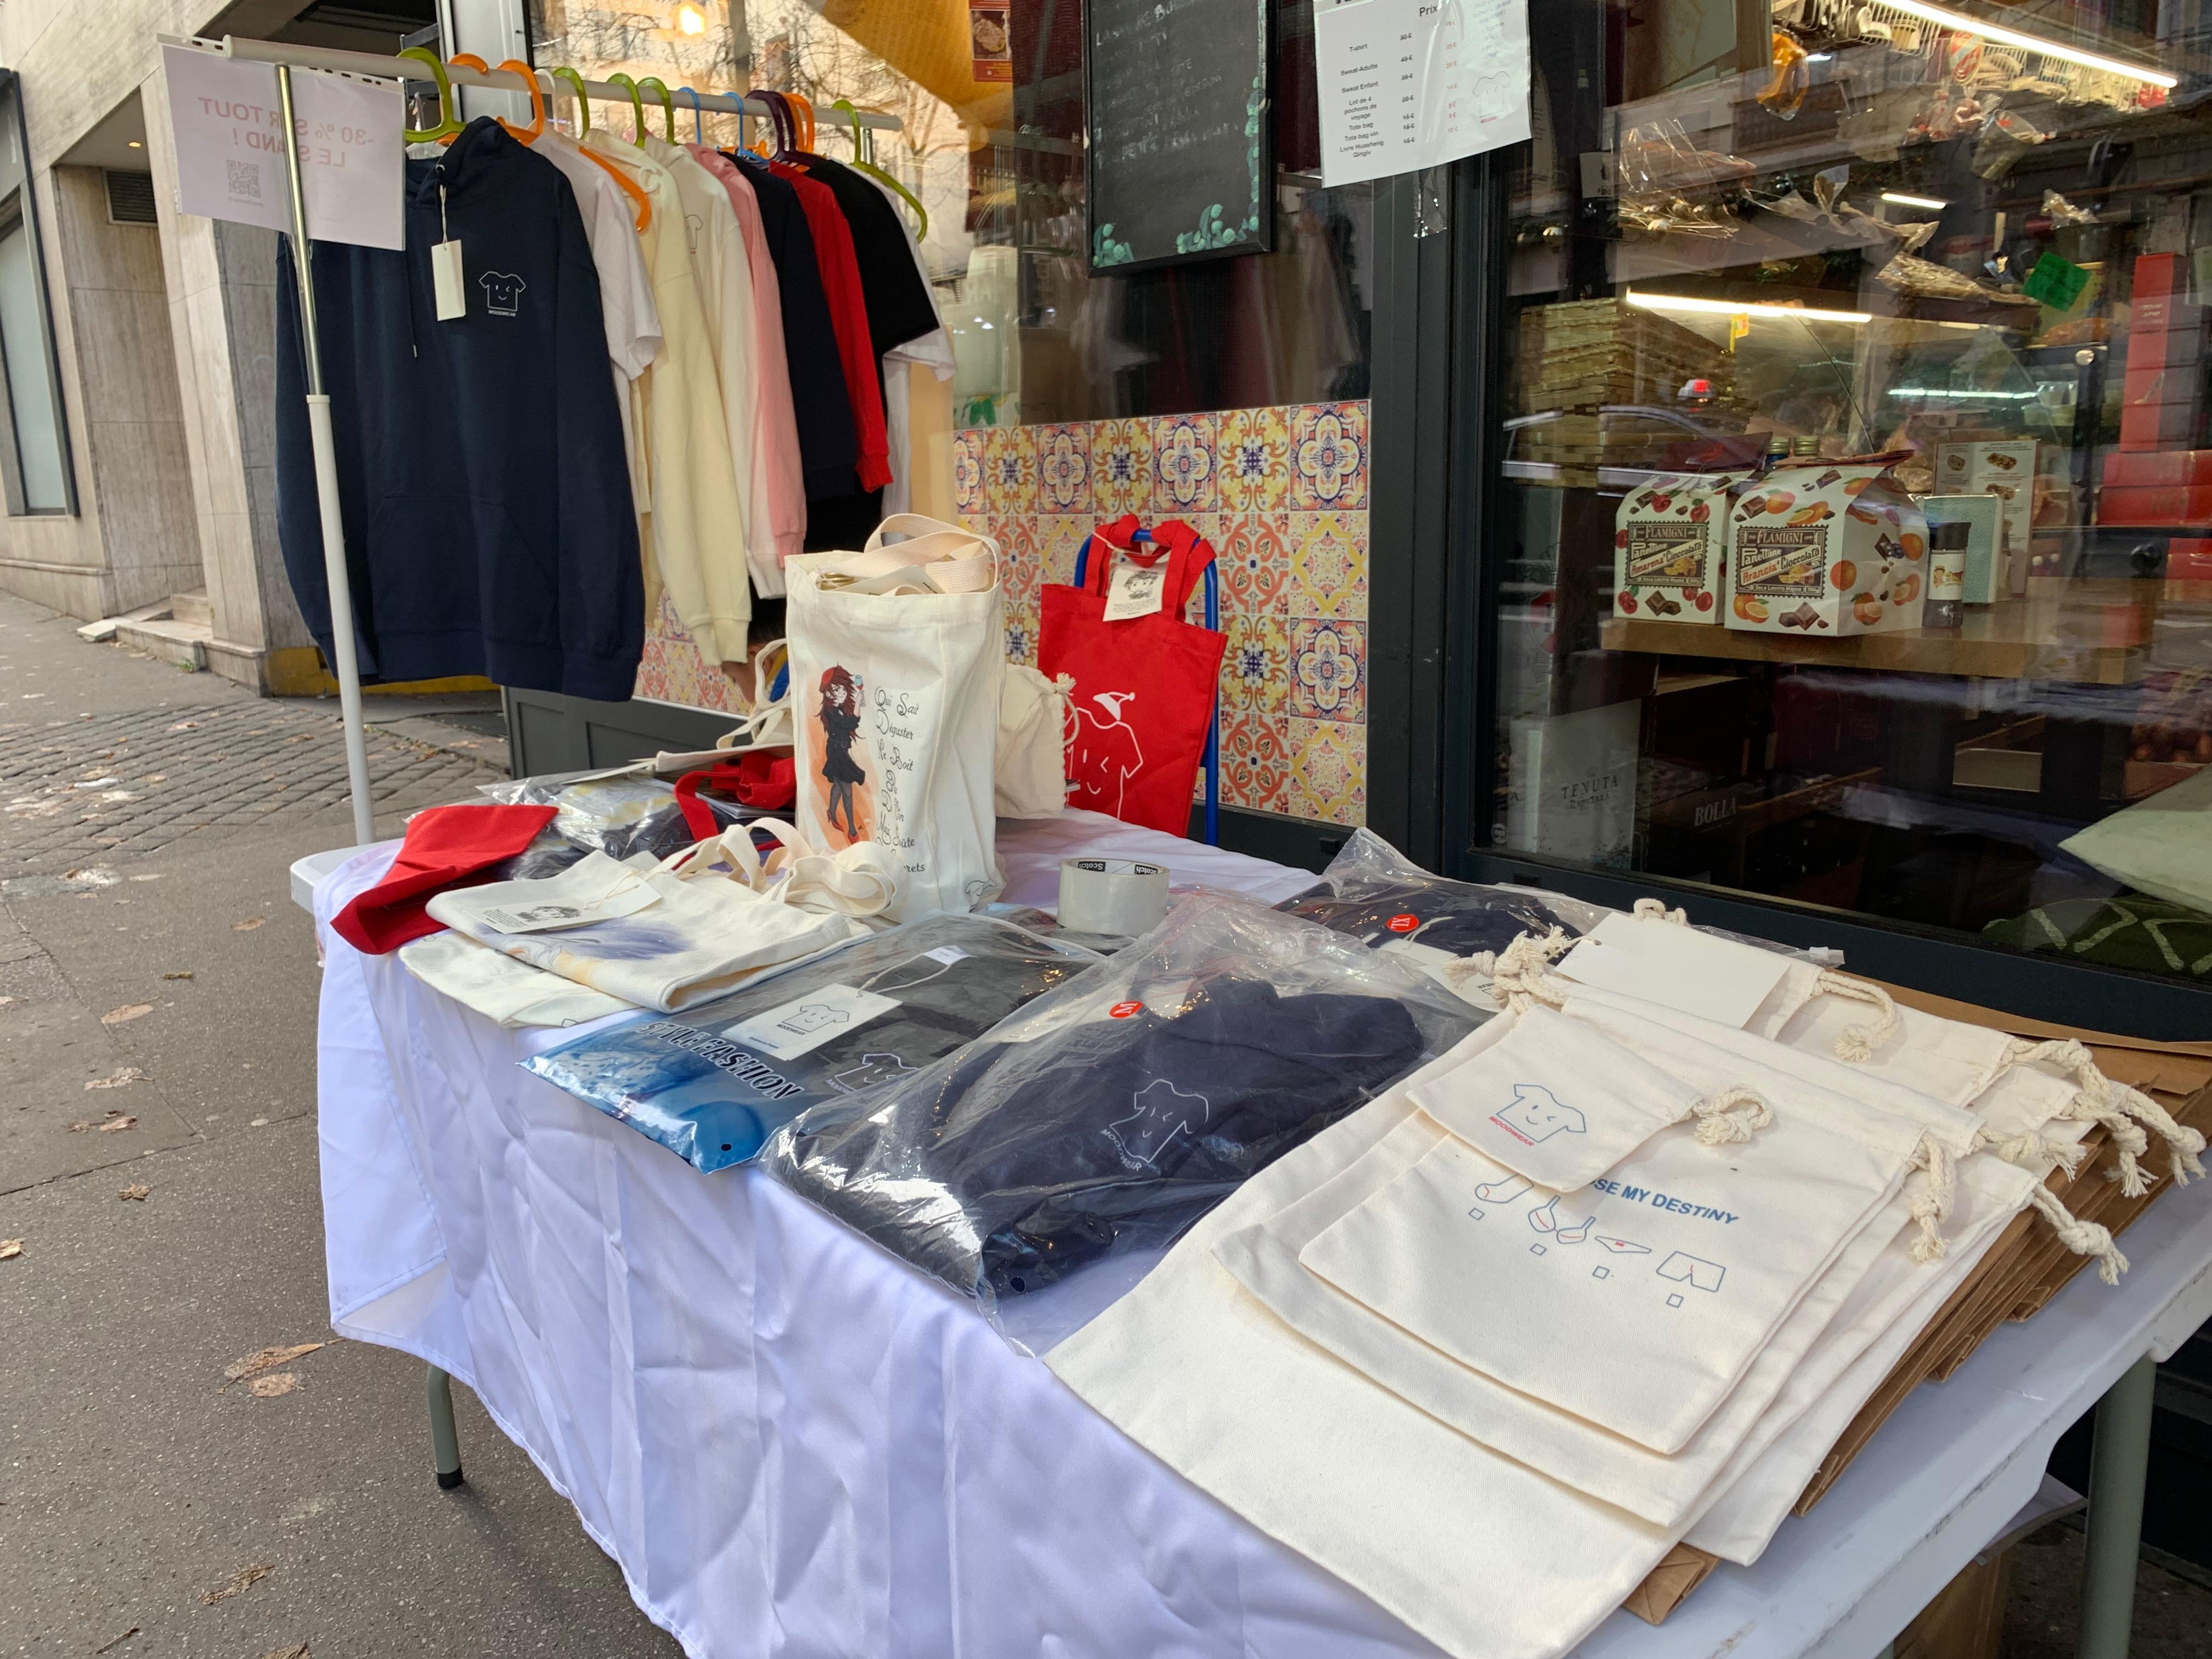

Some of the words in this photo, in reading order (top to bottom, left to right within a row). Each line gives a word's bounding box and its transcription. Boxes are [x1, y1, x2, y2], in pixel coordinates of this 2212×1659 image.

[1419, 4, 1437, 16] Prix
[1349, 44, 1368, 52] T-shirt
[1360, 81, 1378, 89] Enfant
[1344, 105, 1368, 115] pochons
[1645, 525, 1687, 539] FLAMIGNI
[1757, 530, 1803, 544] FLAMIGNI
[1741, 548, 1782, 567] Panettone
[1743, 563, 1778, 584] Arancia
[1781, 547, 1820, 569] Cioccolato
[875, 686, 893, 711] Qui
[897, 693, 919, 718] Sait
[890, 744, 913, 771] Boit
[1562, 775, 1618, 799] TENUTA
[1694, 797, 1736, 826] BOLLA
[1391, 917, 1411, 929] XL
[1114, 1002, 1138, 1014] M
[777, 1024, 805, 1035] MOODWEAR
[636, 1022, 711, 1049] STYLE
[689, 1038, 805, 1100] FASHION
[1488, 1116, 1534, 1146] MOODWEAR
[1621, 1185, 1651, 1202] MY
[1651, 1193, 1739, 1224] DESTINY
